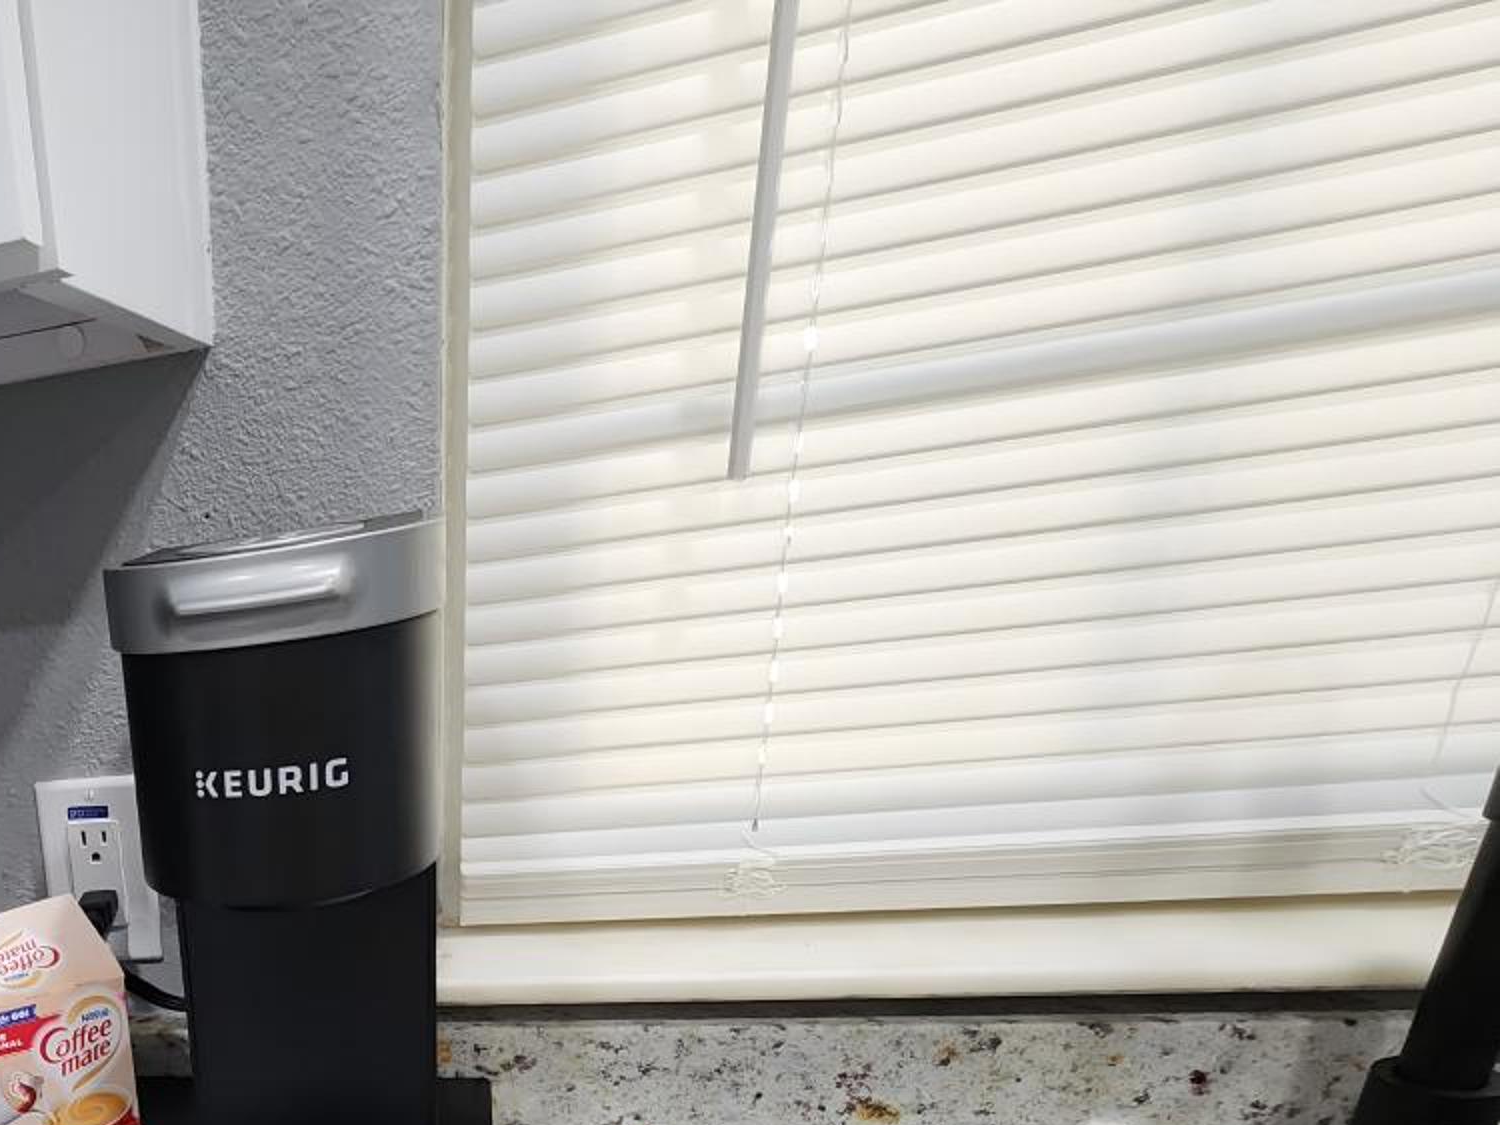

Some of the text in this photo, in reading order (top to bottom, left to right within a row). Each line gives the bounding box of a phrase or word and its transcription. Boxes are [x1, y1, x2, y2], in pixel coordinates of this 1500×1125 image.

[196, 757, 349, 799] KEURIG
[40, 1019, 112, 1065] Coffee
[61, 1039, 111, 1077] mate
